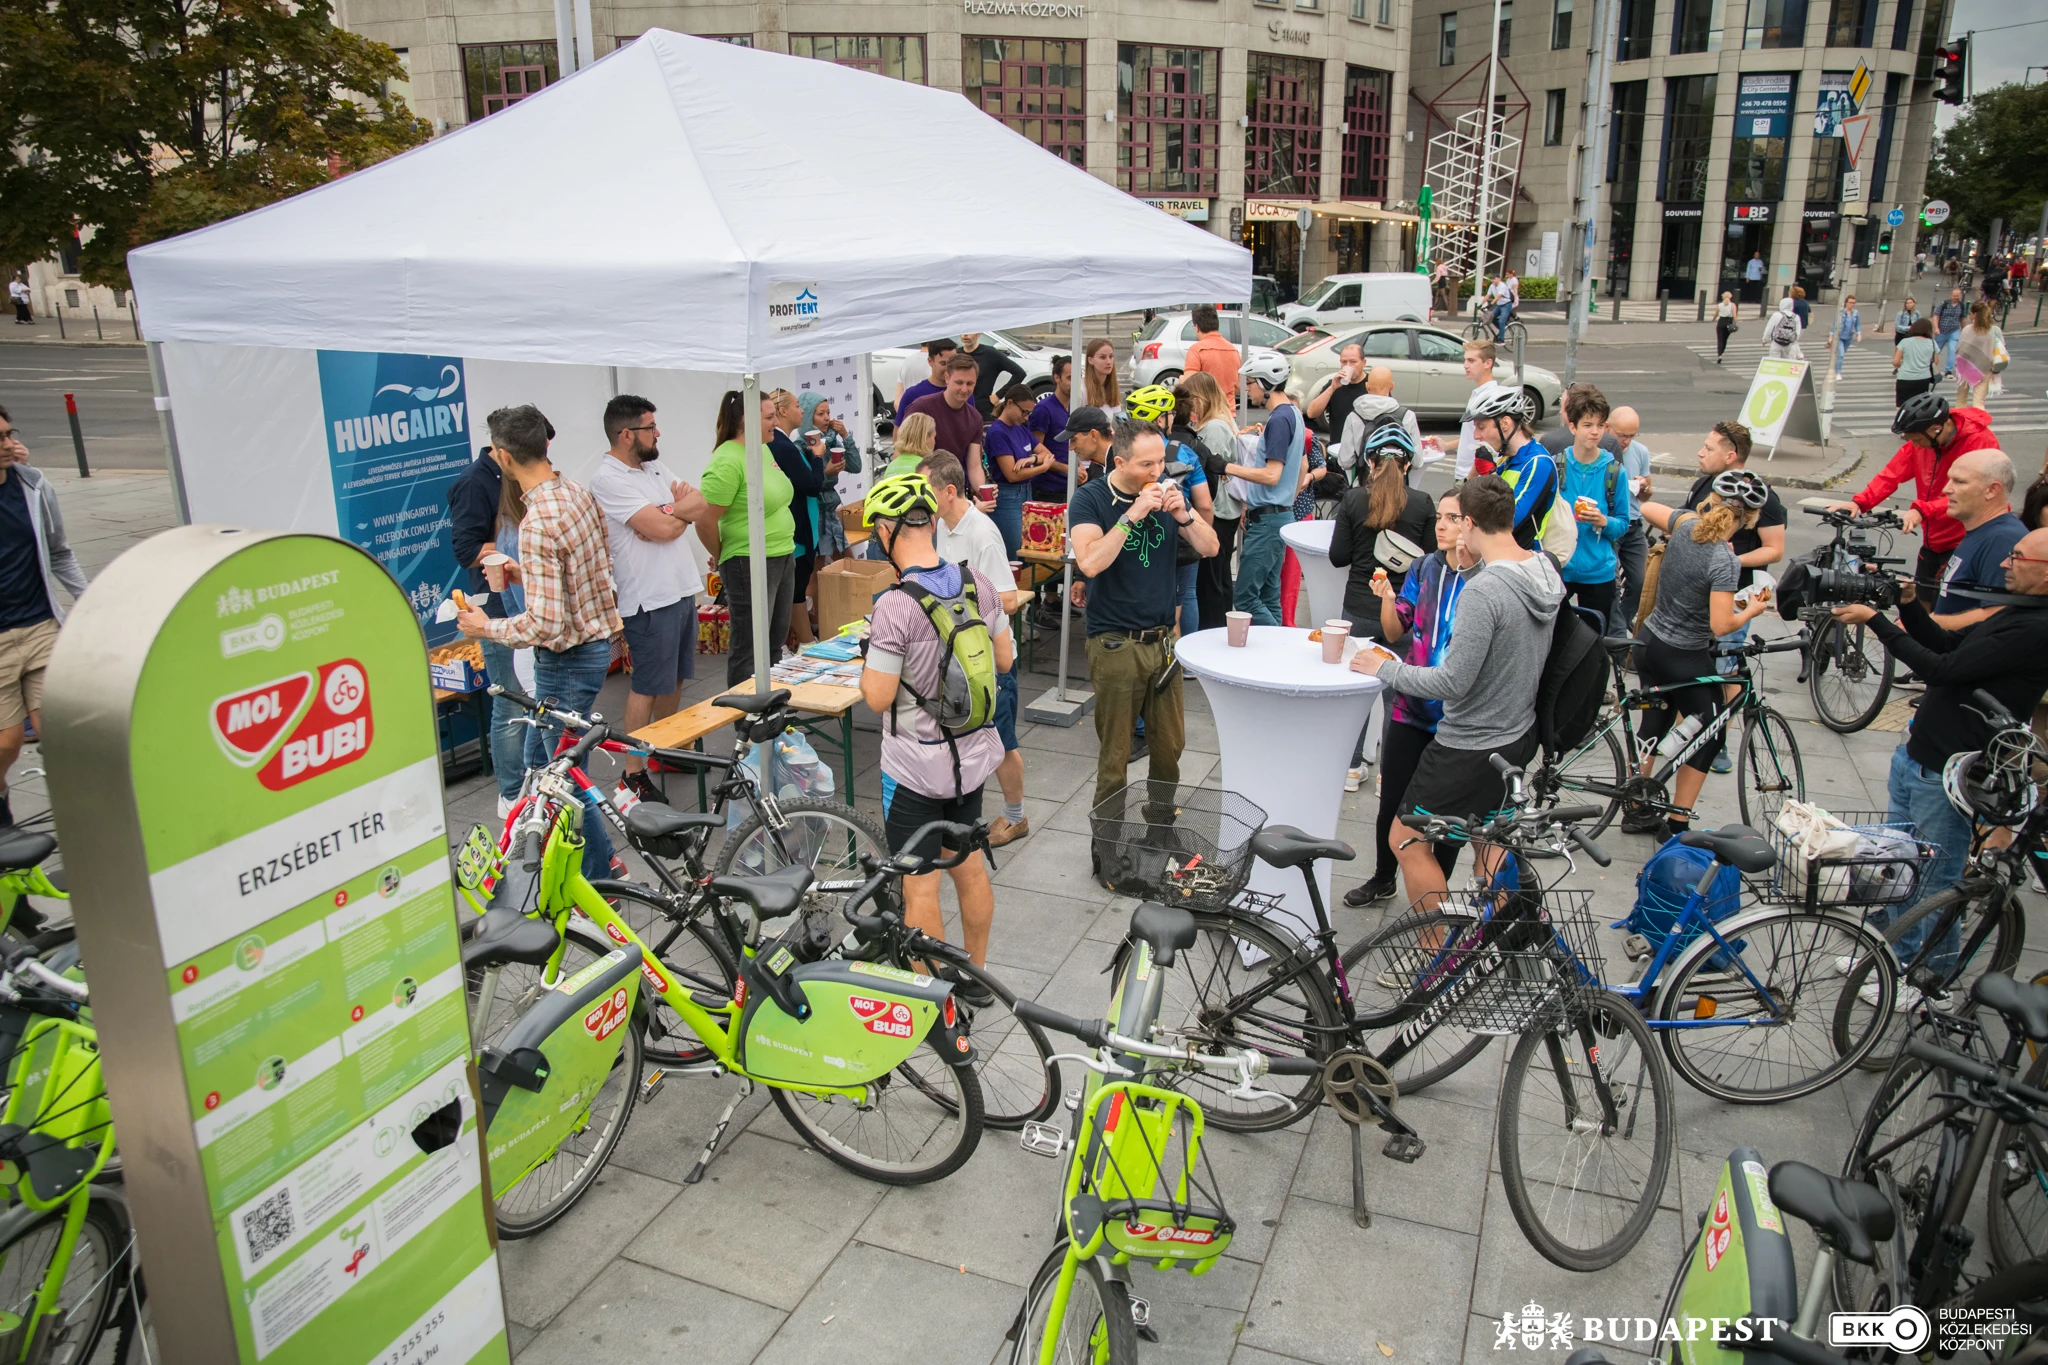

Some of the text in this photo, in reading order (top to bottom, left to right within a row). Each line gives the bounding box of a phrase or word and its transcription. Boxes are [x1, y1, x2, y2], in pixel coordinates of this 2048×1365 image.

[964, 0, 1085, 19] PLAZMA KÖZPONT
[1167, 201, 1204, 210] TRAVEL
[1249, 203, 1280, 217] UCCA
[769, 302, 819, 317] PROFITENT
[333, 402, 464, 453] HUNGAIRY
[342, 482, 348, 490] A
[384, 473, 401, 481] TERVEK
[373, 504, 439, 528] WWW.HUNGAIRY.HU
[256, 570, 340, 603] BUDAPEST
[288, 600, 334, 620] BUDAPESTI
[230, 608, 345, 649] BKK KÖZLEKEDÉSI
[291, 623, 331, 641] KÖZPONT
[227, 691, 283, 734] MOL
[282, 717, 366, 780] BUBI
[1672, 708, 1731, 773] MERIDA
[238, 811, 386, 897] ERZSÉBET TÉR
[608, 925, 623, 940] MOL
[853, 999, 875, 1011] MOL
[588, 1007, 604, 1027] MOL
[602, 1006, 627, 1037] BUBI
[873, 1019, 912, 1037] BUBI
[772, 1040, 814, 1059] BUDAPEST
[508, 1114, 551, 1148] BUDAPEST
[1172, 1229, 1211, 1243] BUBI
[392, 1311, 445, 1365] 3 255 255
